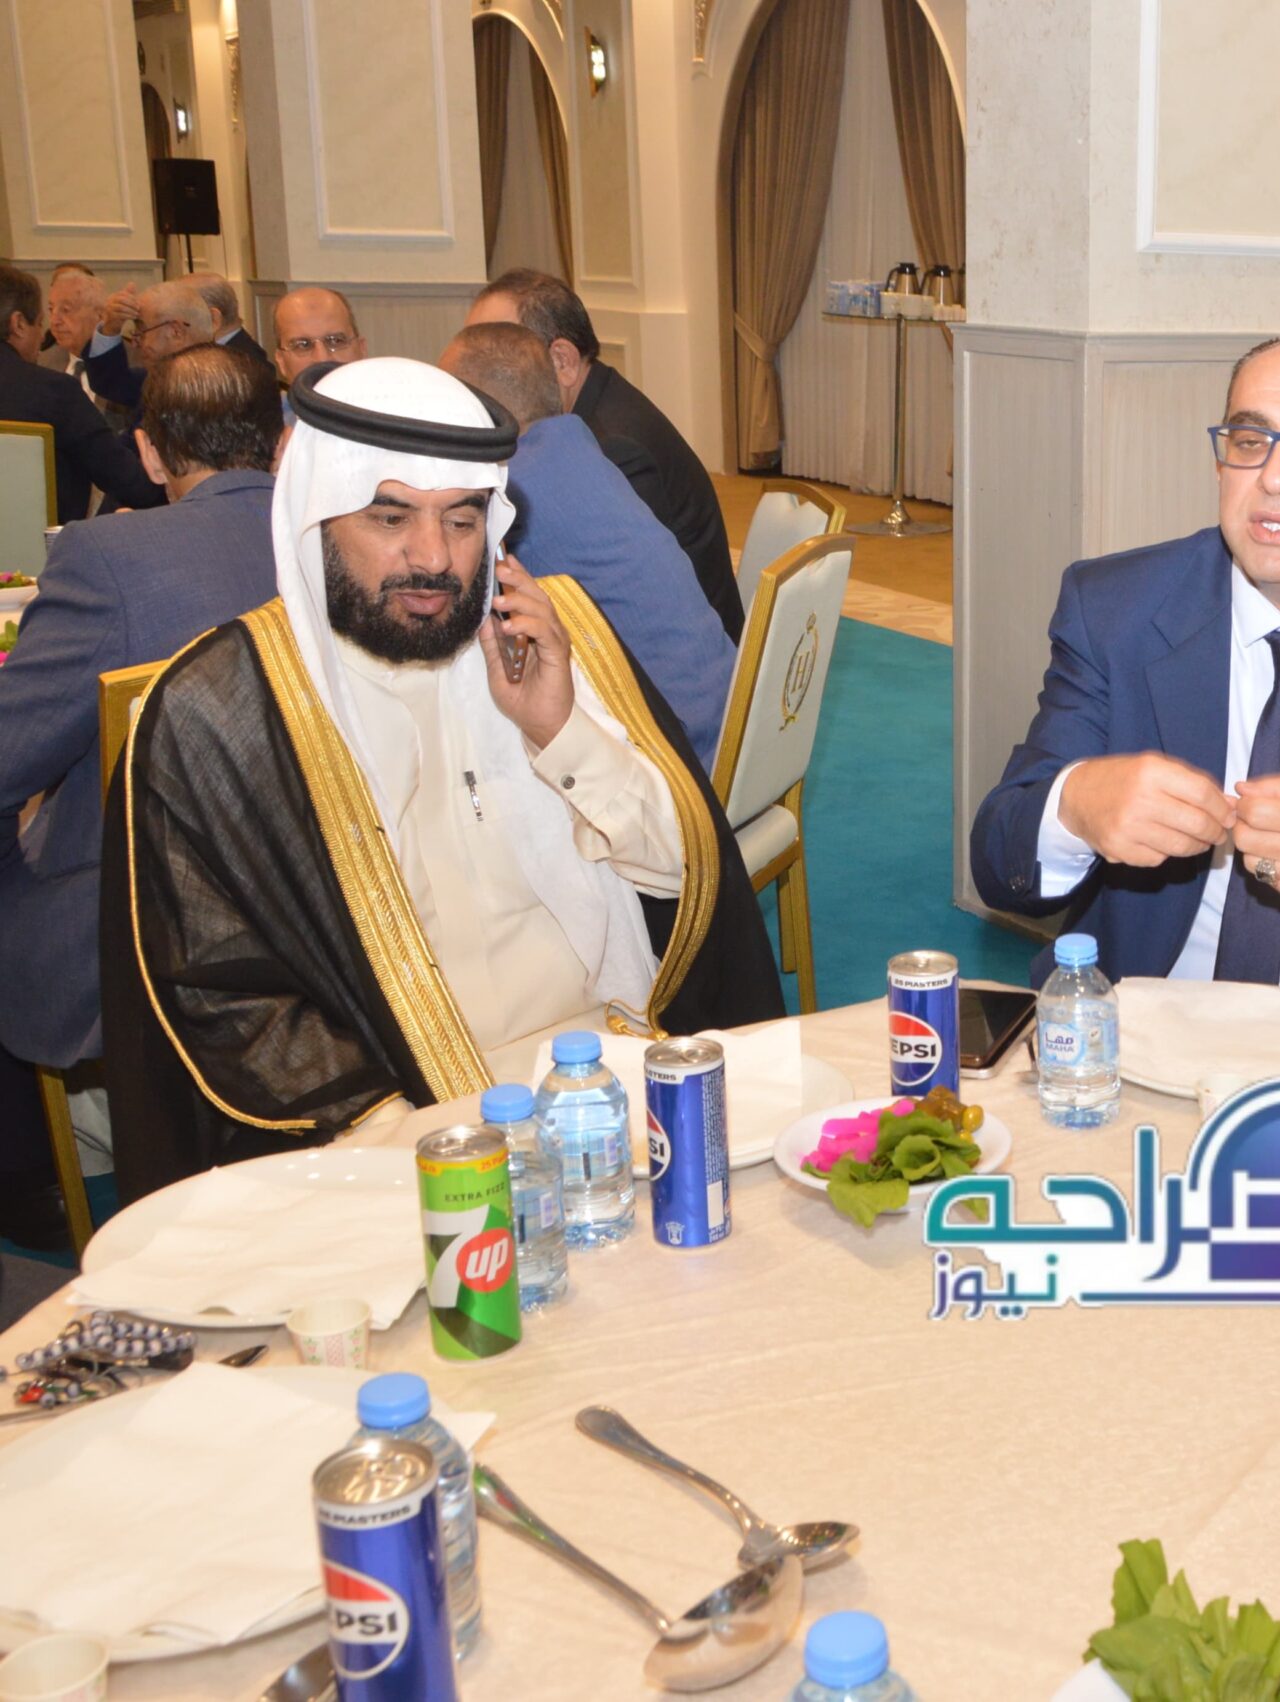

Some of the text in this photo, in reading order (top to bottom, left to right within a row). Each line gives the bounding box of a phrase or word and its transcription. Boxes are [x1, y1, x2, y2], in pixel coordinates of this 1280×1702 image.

[905, 979, 949, 987] PIASTERS
[891, 1038, 937, 1059] EPSI
[444, 1181, 505, 1203] EXTRA FIZZ
[423, 1203, 490, 1308] 7
[335, 1609, 398, 1636] PSI
